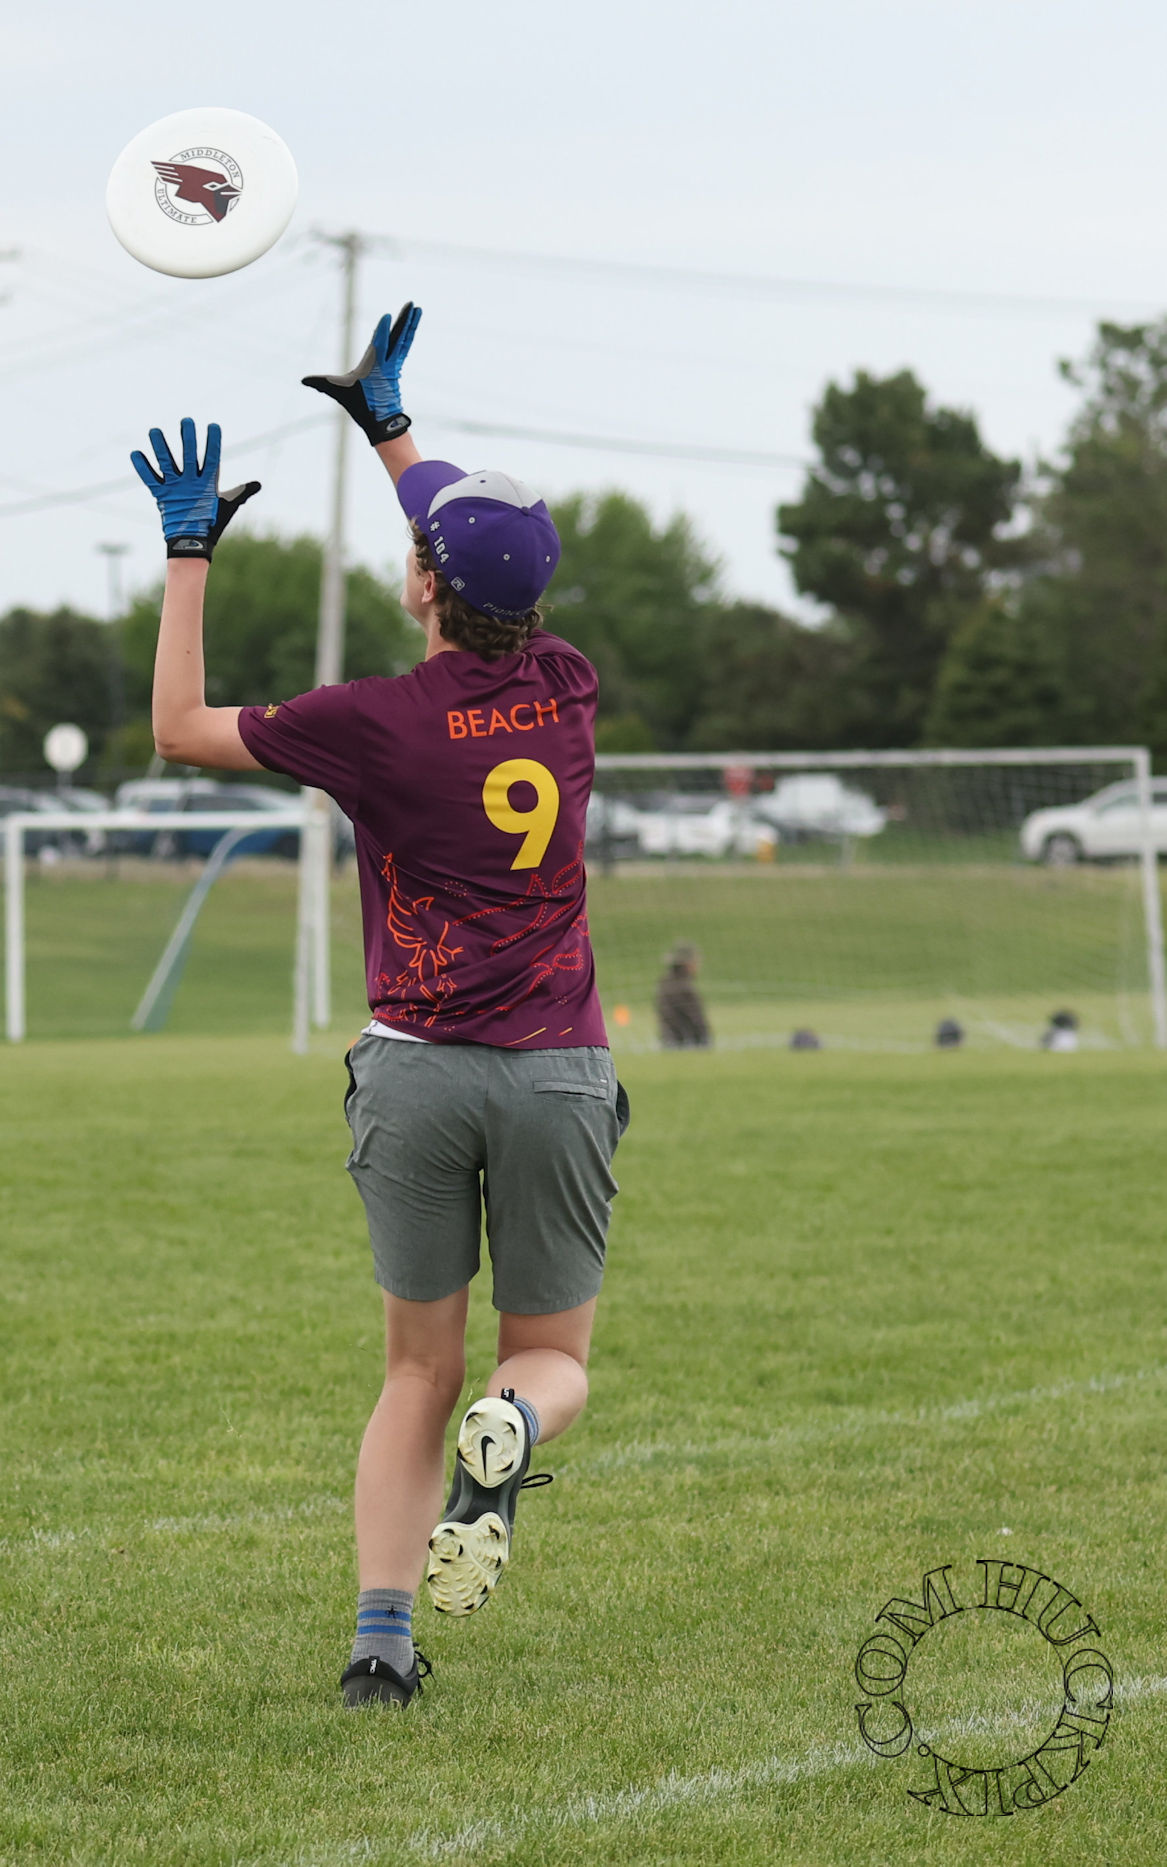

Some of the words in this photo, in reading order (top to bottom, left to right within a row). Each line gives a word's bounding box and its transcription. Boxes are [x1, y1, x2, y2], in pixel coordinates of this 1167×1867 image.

[180, 149, 240, 178] MIDDLETON
[157, 188, 198, 223] ULTIMATE
[447, 698, 560, 740] BEACH
[482, 758, 560, 871] 9
